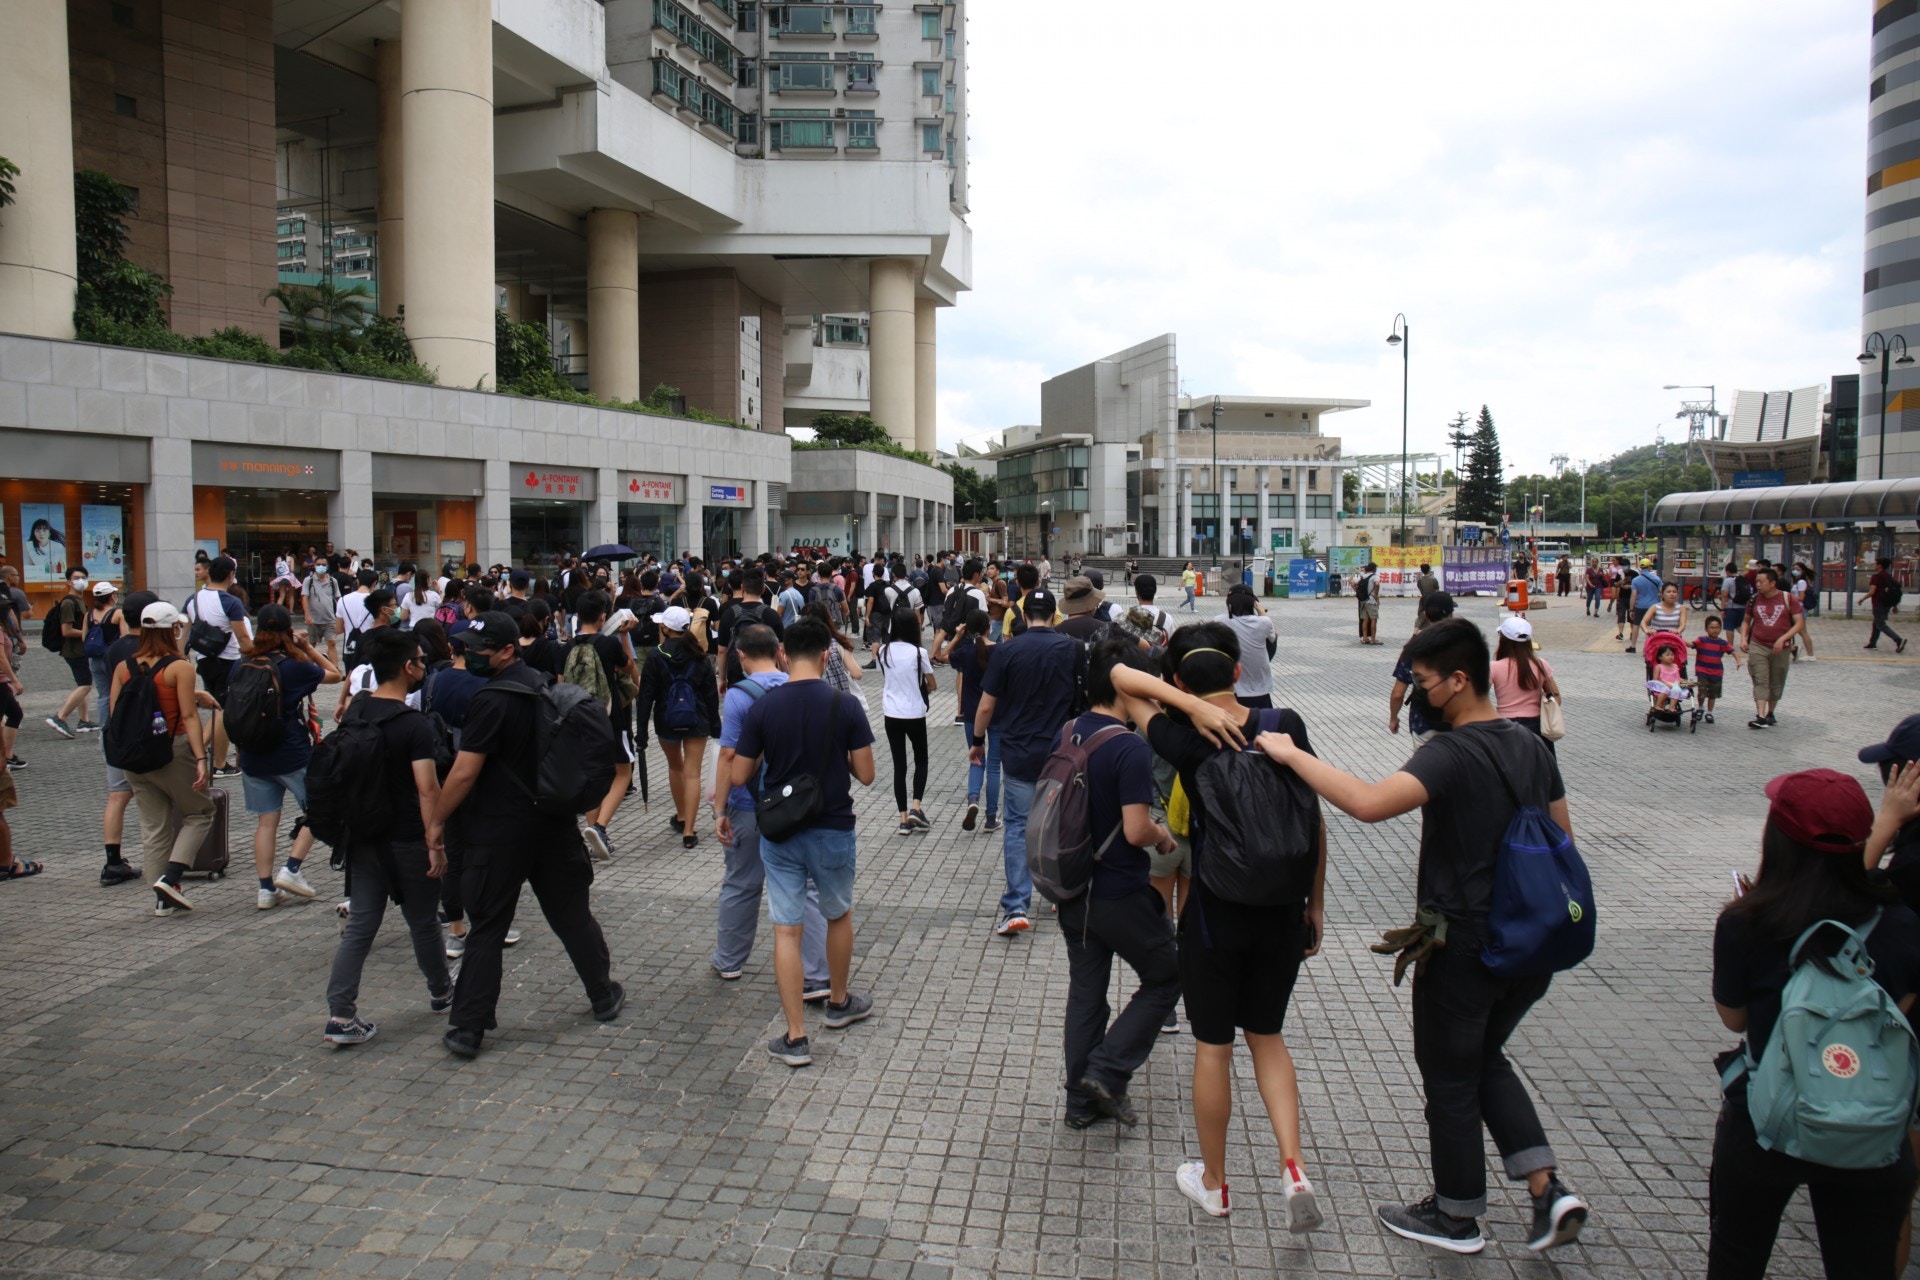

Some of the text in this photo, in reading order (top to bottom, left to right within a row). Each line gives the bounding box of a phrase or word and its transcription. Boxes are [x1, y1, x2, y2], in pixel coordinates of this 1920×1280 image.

[242, 461, 302, 477] mannings
[541, 474, 580, 484] A-FONTANE
[641, 480, 672, 490] A-FONTANE
[793, 538, 840, 547] BOOKS
[1375, 546, 1437, 557] 法輪大法好
